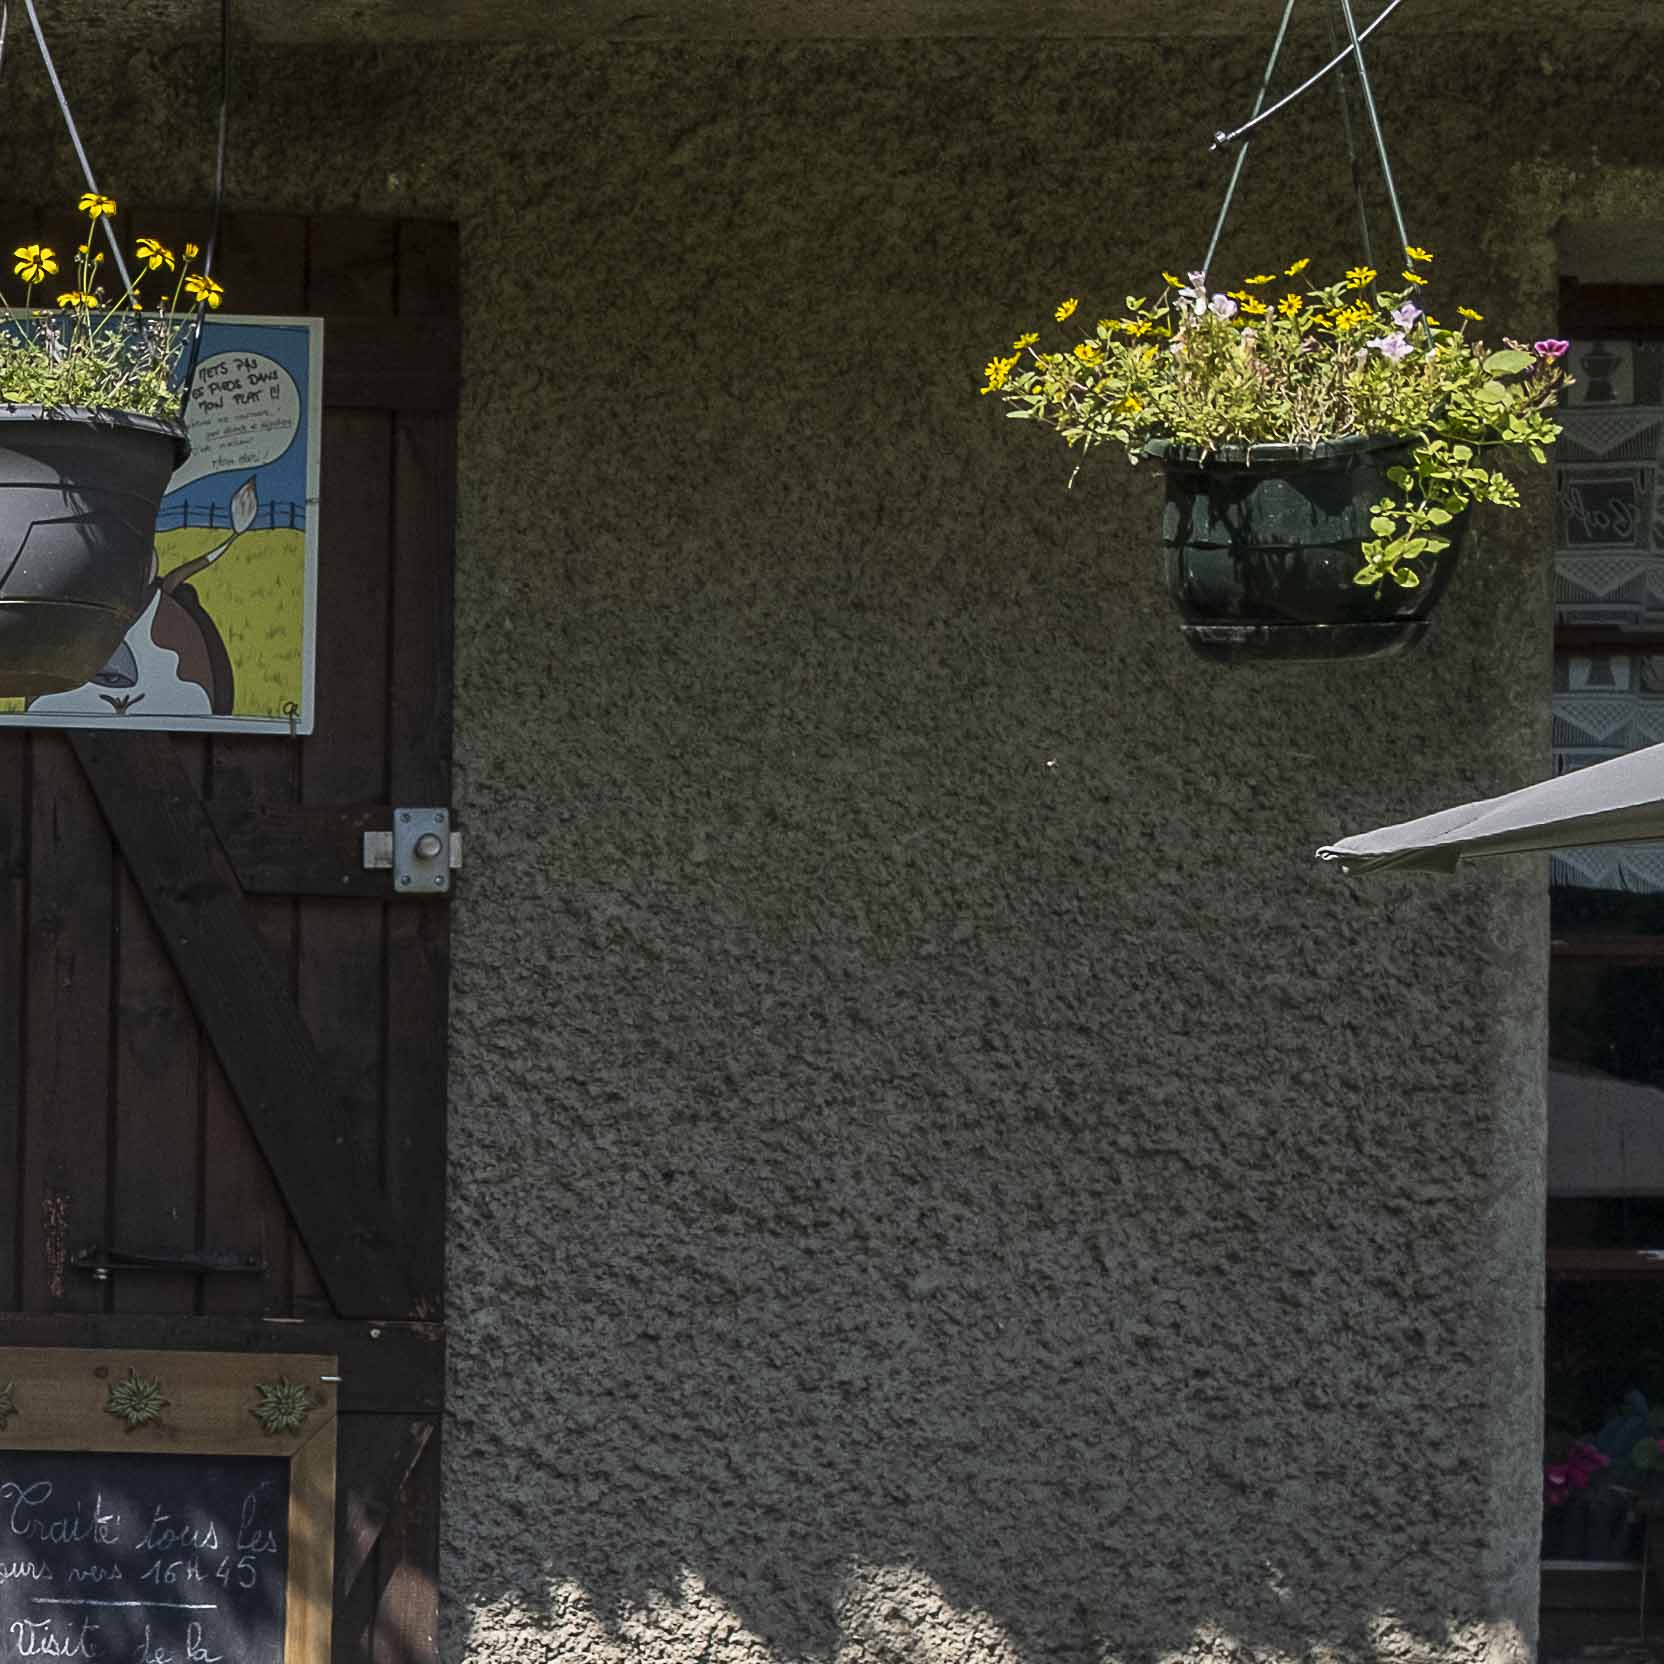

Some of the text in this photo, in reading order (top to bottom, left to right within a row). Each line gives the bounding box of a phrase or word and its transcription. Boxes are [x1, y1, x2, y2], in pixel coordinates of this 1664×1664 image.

[135, 1503, 219, 1552] tous
[236, 1494, 278, 1553] les
[67, 1563, 124, 1585] vers
[137, 1623, 174, 1664] de
[186, 1621, 224, 1664] la
